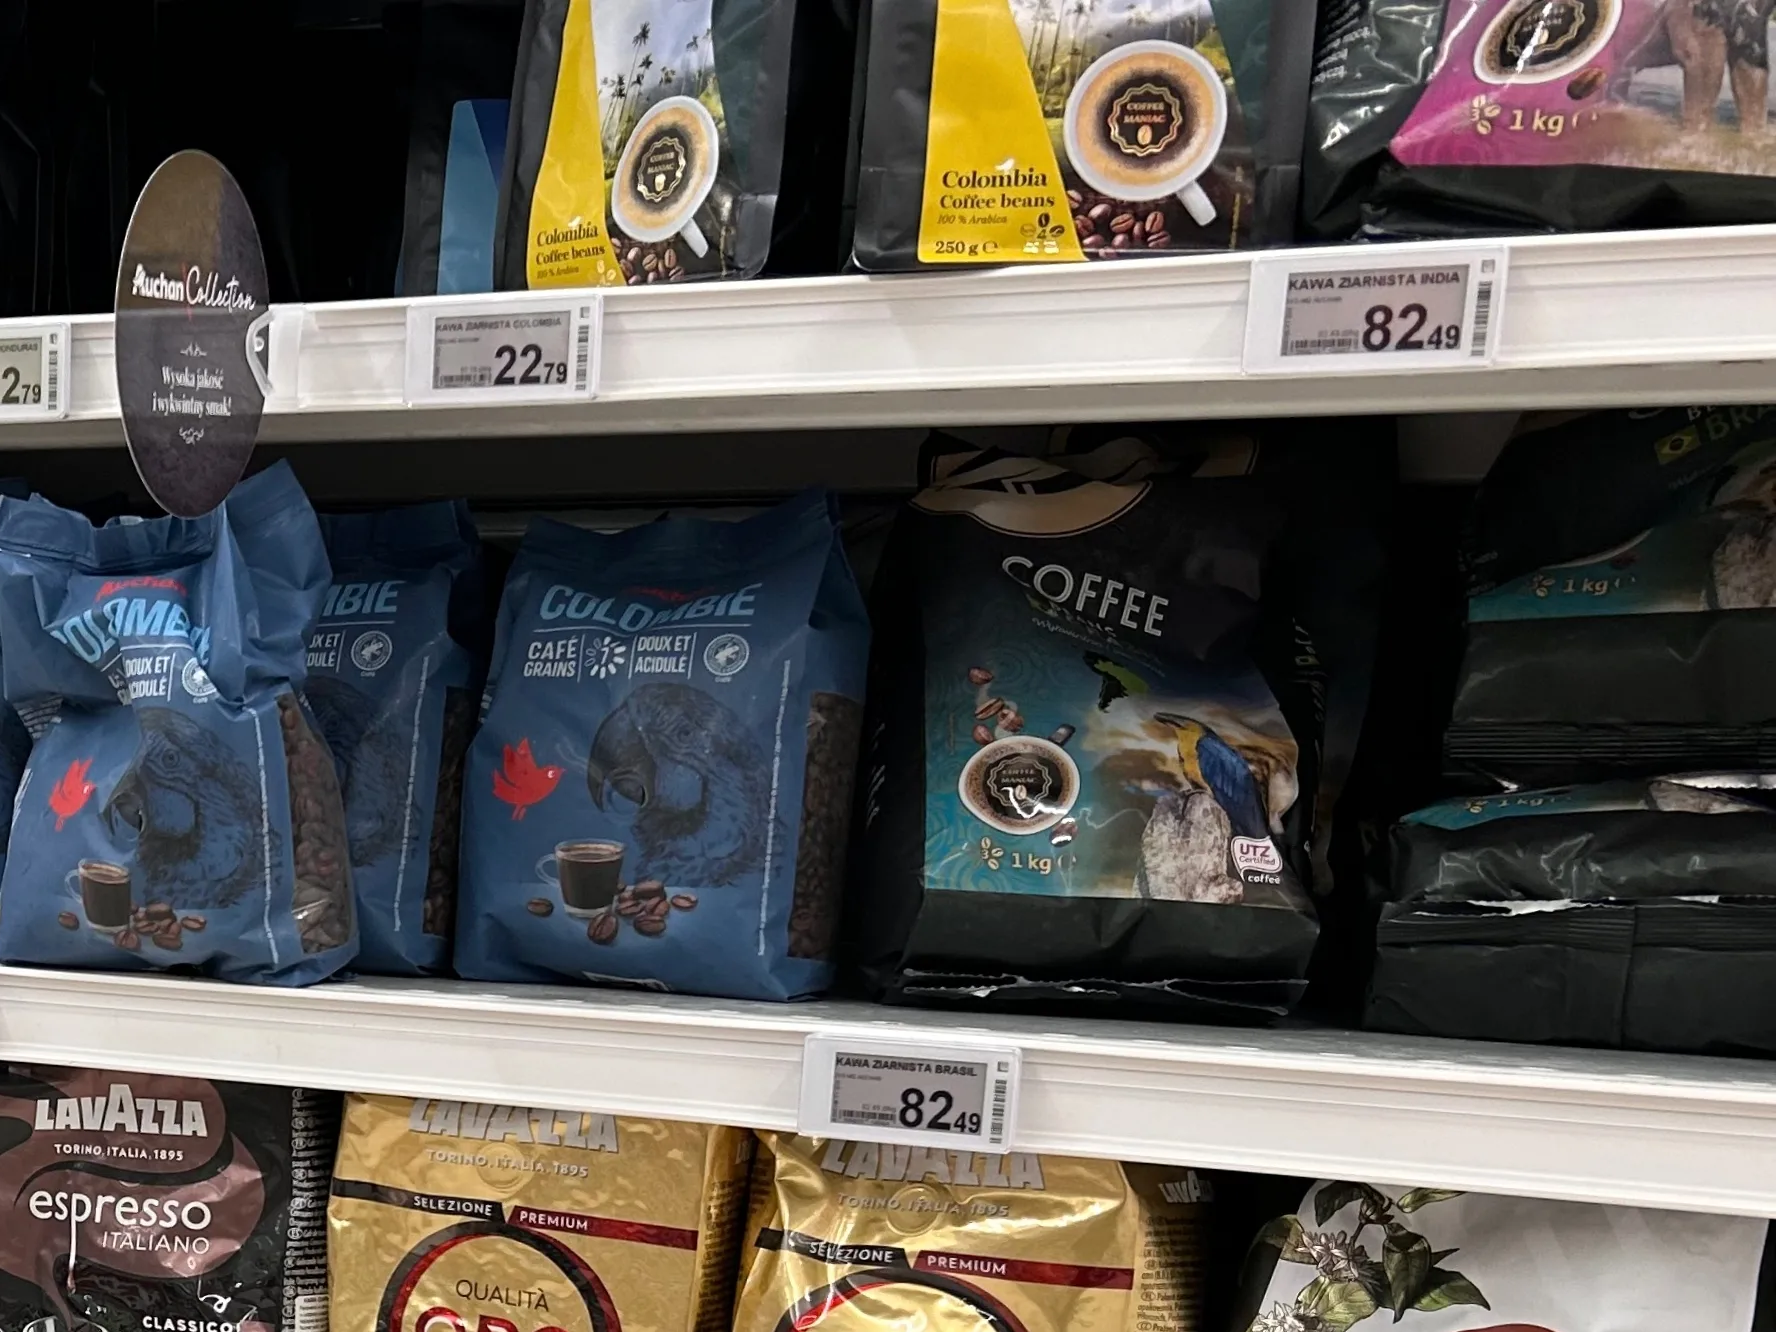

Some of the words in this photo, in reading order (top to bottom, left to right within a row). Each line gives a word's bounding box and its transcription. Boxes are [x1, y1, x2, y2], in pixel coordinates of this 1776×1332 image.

[1510, 113, 1525, 131] 1
[1531, 113, 1564, 137] kg
[942, 167, 1047, 189] Colombia
[940, 194, 996, 210] Coffee
[1000, 192, 1055, 208] beans
[536, 221, 599, 247] Colombia
[535, 249, 570, 265] Coffee
[571, 244, 606, 260] beans
[935, 241, 965, 254] 250
[968, 243, 978, 257] g
[1288, 276, 1334, 291] KAWA
[1338, 272, 1416, 289] ZIARNISTA
[1420, 270, 1460, 285] INDIA
[162, 365, 195, 388] Wysoka
[196, 368, 224, 391] jakość
[1002, 554, 1169, 639] COFFEE
[638, 635, 670, 653] DOUX
[673, 634, 690, 650] ET
[524, 658, 576, 678] GRAINS
[635, 653, 688, 674] ACIDULÉ
[1239, 841, 1271, 860] UTZ
[1012, 853, 1021, 871] 1
[1027, 852, 1053, 874] kg
[836, 1057, 869, 1068] KAWA
[873, 1060, 931, 1073] ZIARNISTA
[936, 1065, 977, 1077] BRASIL
[28, 1189, 211, 1256] espresso
[413, 1195, 493, 1217] SELEZIONE
[519, 1210, 589, 1231] PREMIUM
[102, 1231, 210, 1255] ITALIANO
[455, 1278, 550, 1313] QUALITÀ
